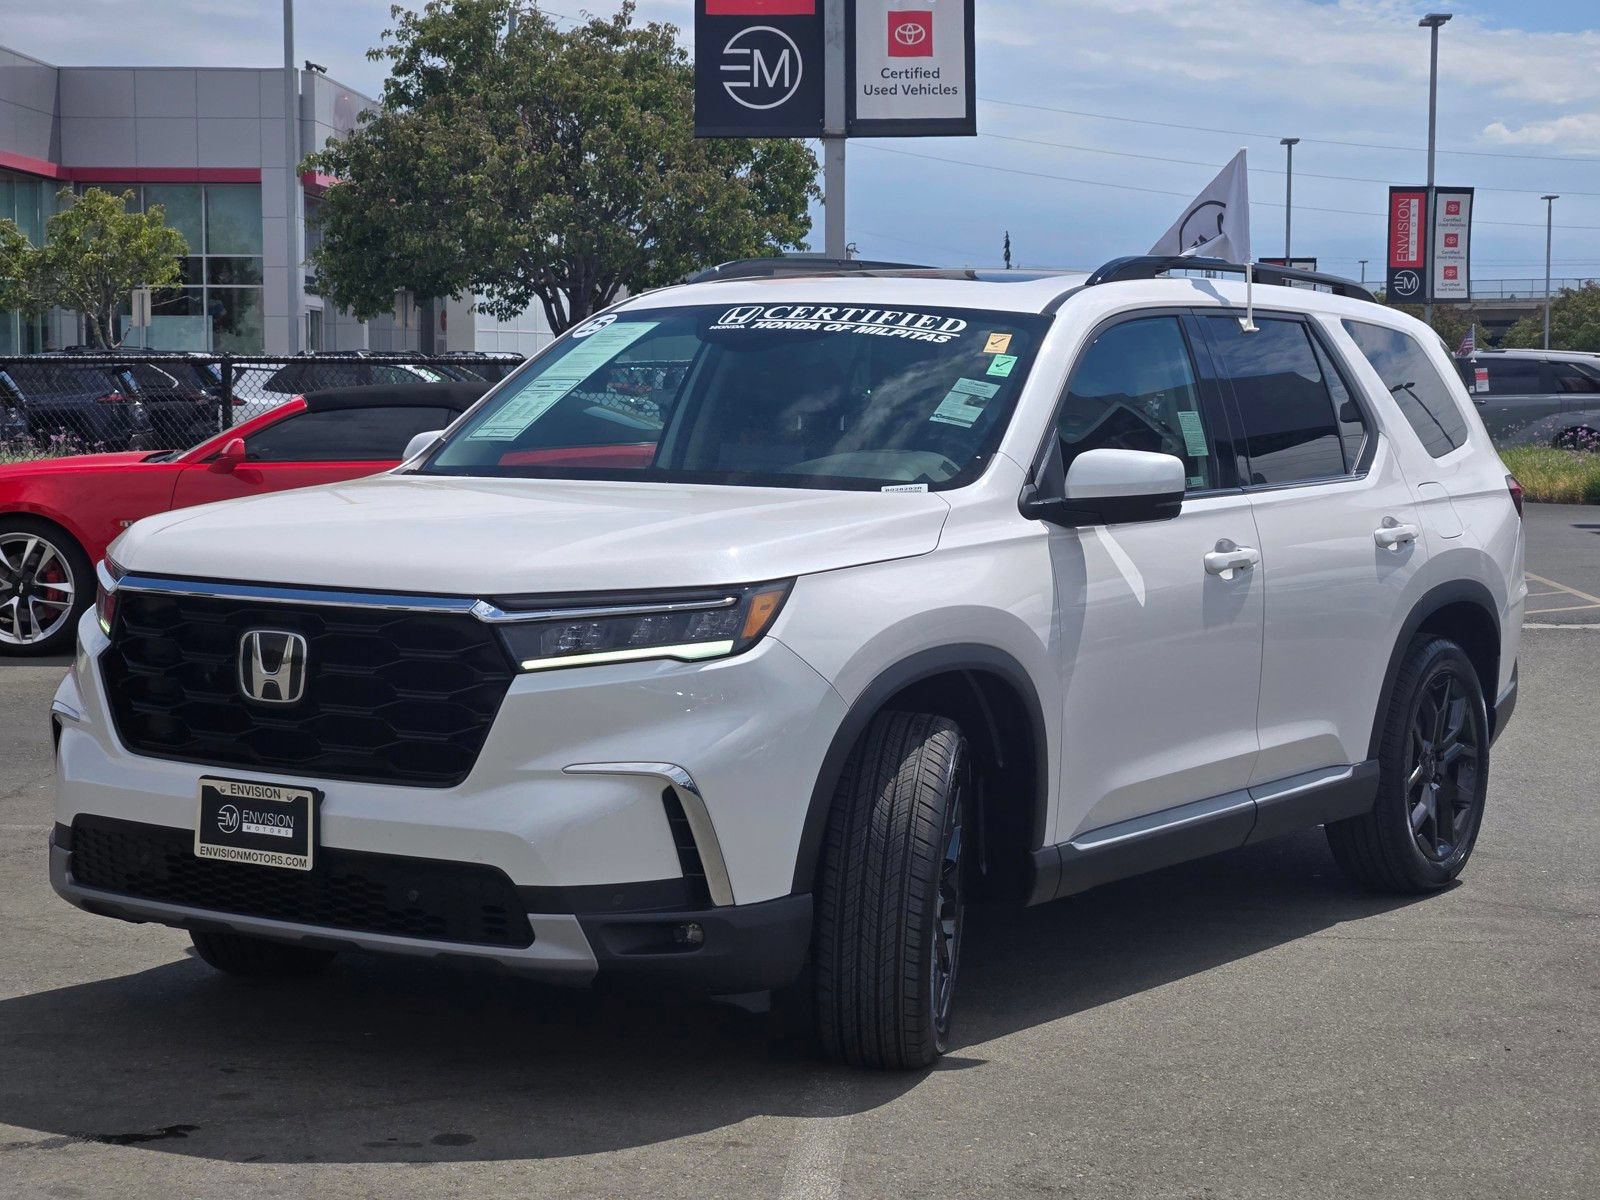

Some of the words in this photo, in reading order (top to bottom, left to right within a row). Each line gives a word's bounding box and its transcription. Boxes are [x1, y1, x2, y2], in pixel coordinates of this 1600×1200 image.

[880, 67, 941, 79] Certified
[863, 84, 898, 96] Used
[901, 84, 958, 96] Vehicles
[1396, 198, 1410, 262] ENVISION
[763, 305, 968, 334] CERTIFIED
[750, 321, 820, 331] HONDA
[823, 323, 852, 332] OF
[852, 325, 952, 344] MILPITAS
[230, 784, 281, 799] ENVISION
[242, 809, 294, 828] ENVISION
[246, 825, 289, 836] MOTORS
[200, 846, 307, 868] ENVISIONMOTORS.COM
